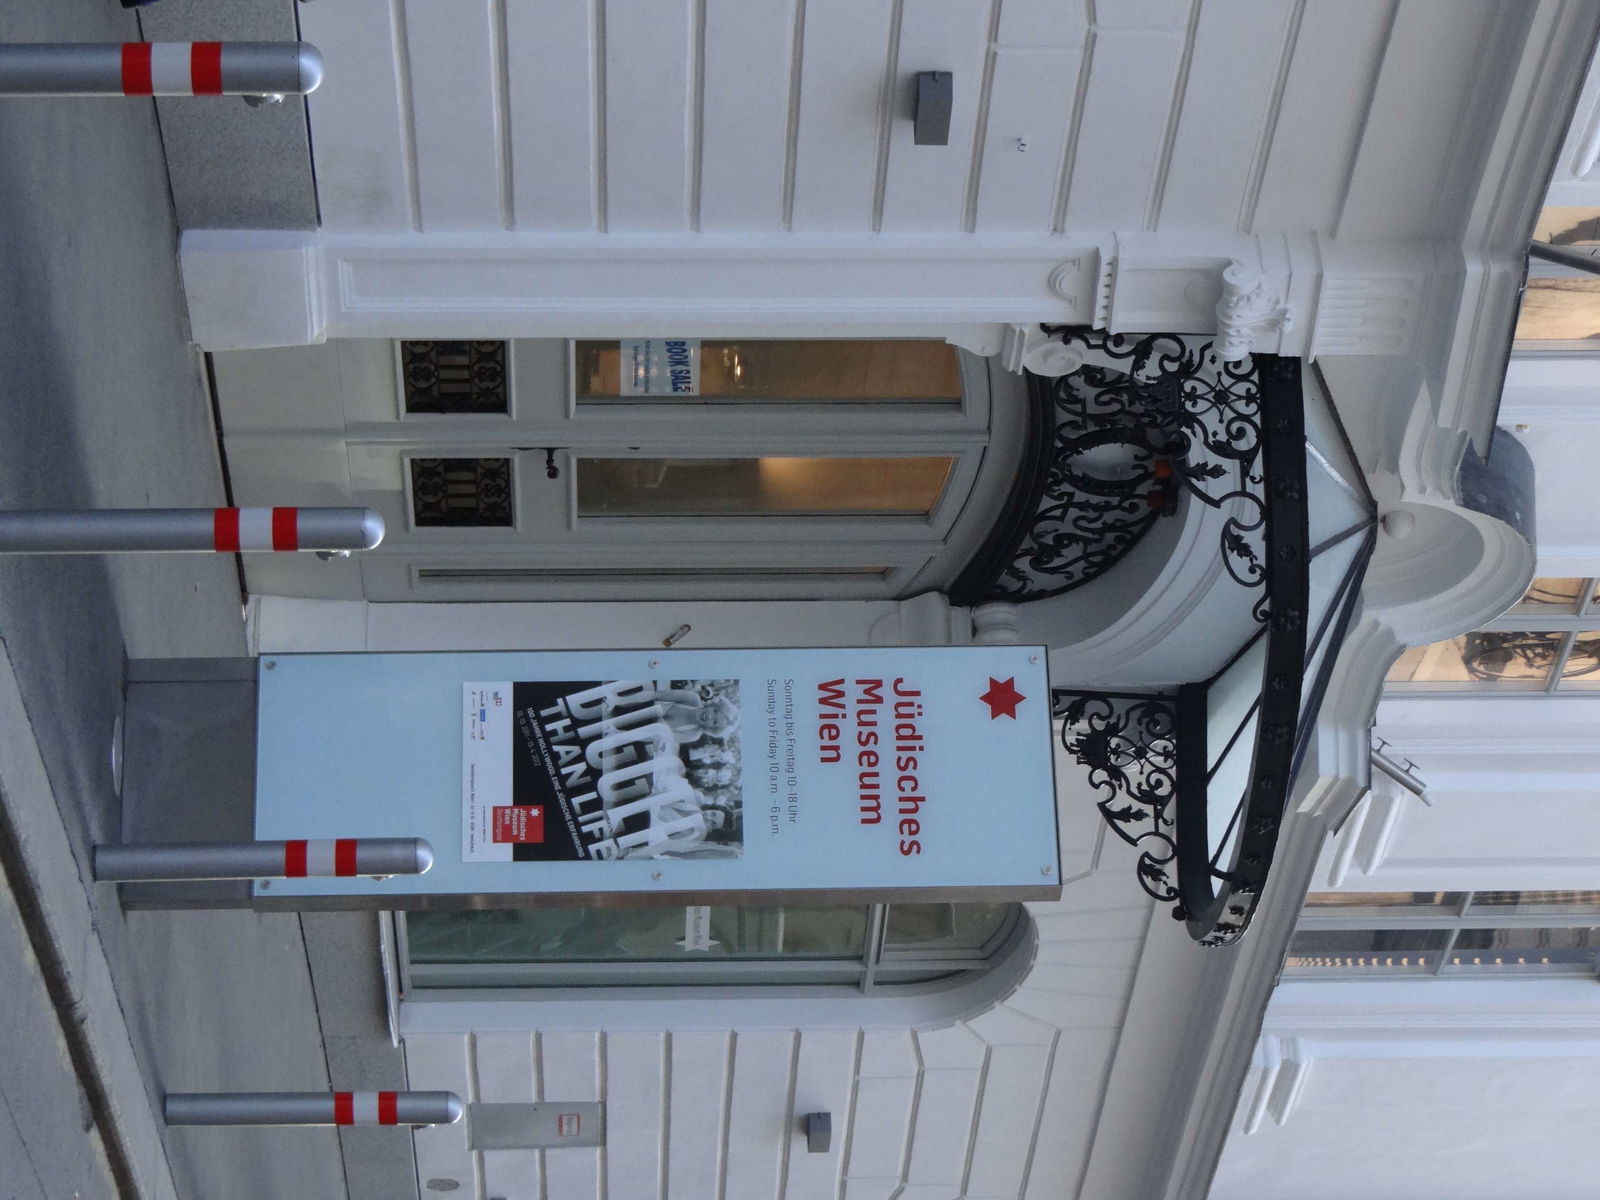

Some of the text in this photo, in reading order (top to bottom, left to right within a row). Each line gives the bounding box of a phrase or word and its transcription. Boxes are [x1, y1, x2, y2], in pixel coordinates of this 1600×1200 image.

[664, 340, 692, 392] BOOK SALE
[766, 678, 778, 714] Sunday
[783, 678, 795, 720] Sonntag
[768, 717, 777, 727] to
[786, 722, 796, 736] bis
[818, 678, 846, 764] Wien
[767, 729, 779, 760] Friday
[785, 738, 796, 774] Freitag
[855, 679, 884, 824] Museum
[526, 707, 585, 858] 100 JAHRE HOLLYWOOD. EINE JÜDISCHE ERFAHRUNG
[539, 698, 616, 860] THAN LIFE
[769, 762, 780, 773] 10
[770, 774, 778, 796] a.m.
[893, 678, 926, 856] Jüdisches
[520, 808, 528, 840] Jüdisches
[768, 815, 780, 837] p.m.
[788, 805, 798, 824] Uhr
